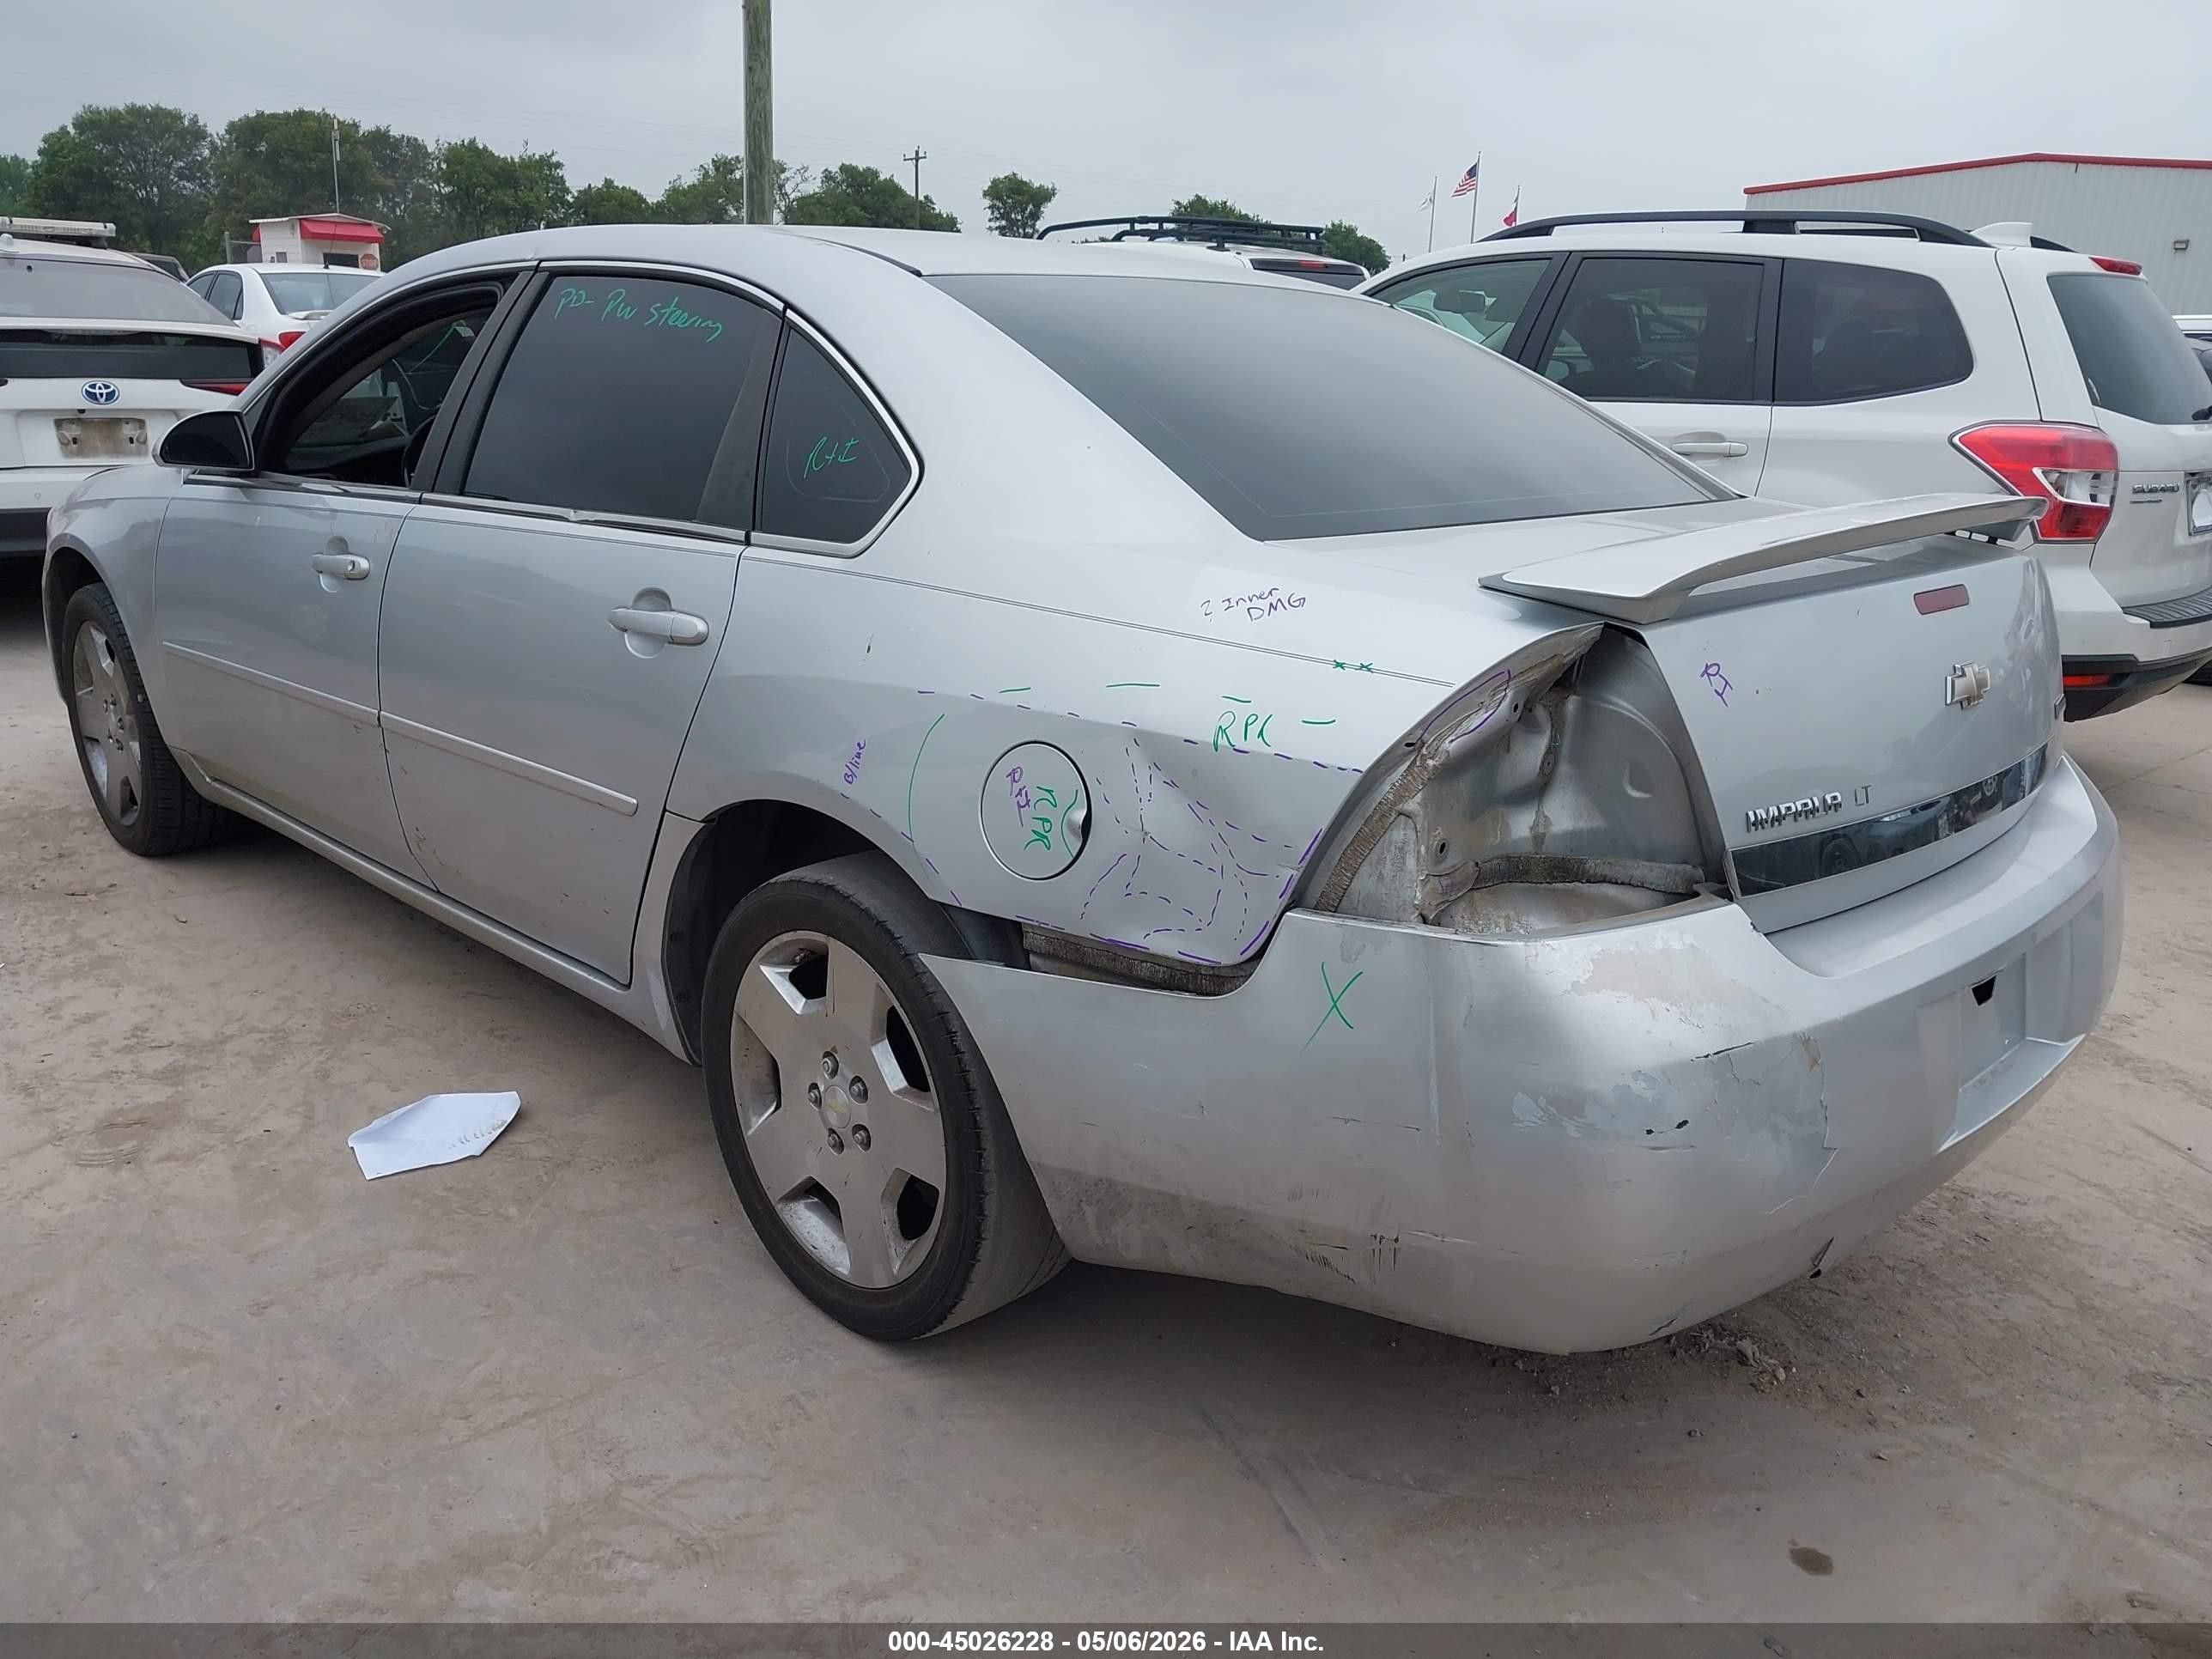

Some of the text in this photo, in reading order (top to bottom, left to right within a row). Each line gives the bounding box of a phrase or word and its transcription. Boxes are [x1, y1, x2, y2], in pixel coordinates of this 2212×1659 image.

[2132, 483, 2180, 494] SUBARU
[1247, 592, 1306, 622] DMG
[1746, 785, 1872, 833] IMPALA LT
